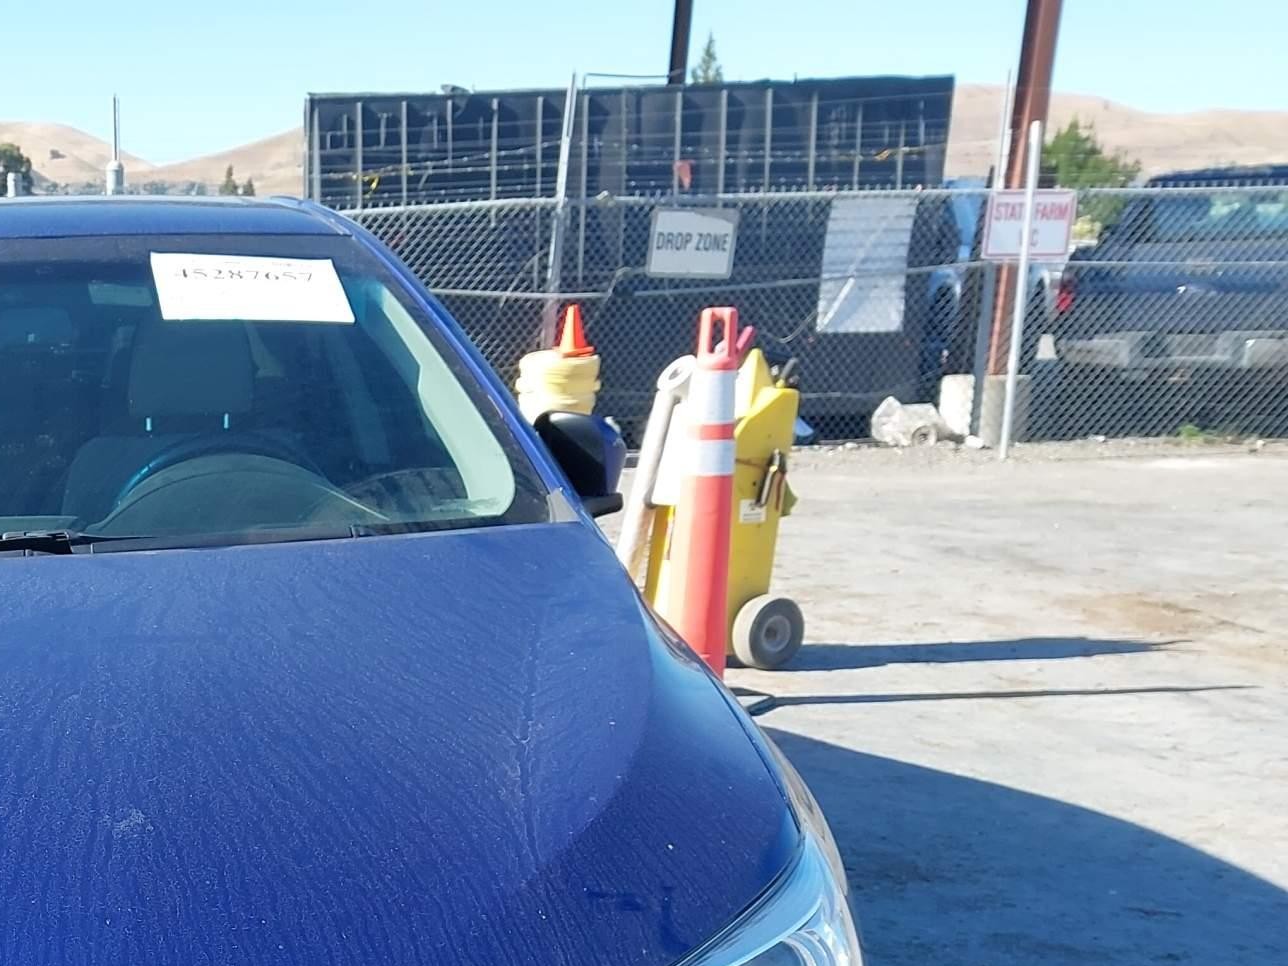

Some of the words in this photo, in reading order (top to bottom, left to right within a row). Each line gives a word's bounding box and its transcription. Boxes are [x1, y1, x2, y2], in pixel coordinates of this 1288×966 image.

[993, 202, 1029, 221] STAT
[1035, 201, 1070, 220] FARM
[655, 232, 692, 250] DROP
[695, 232, 729, 251] ZONE
